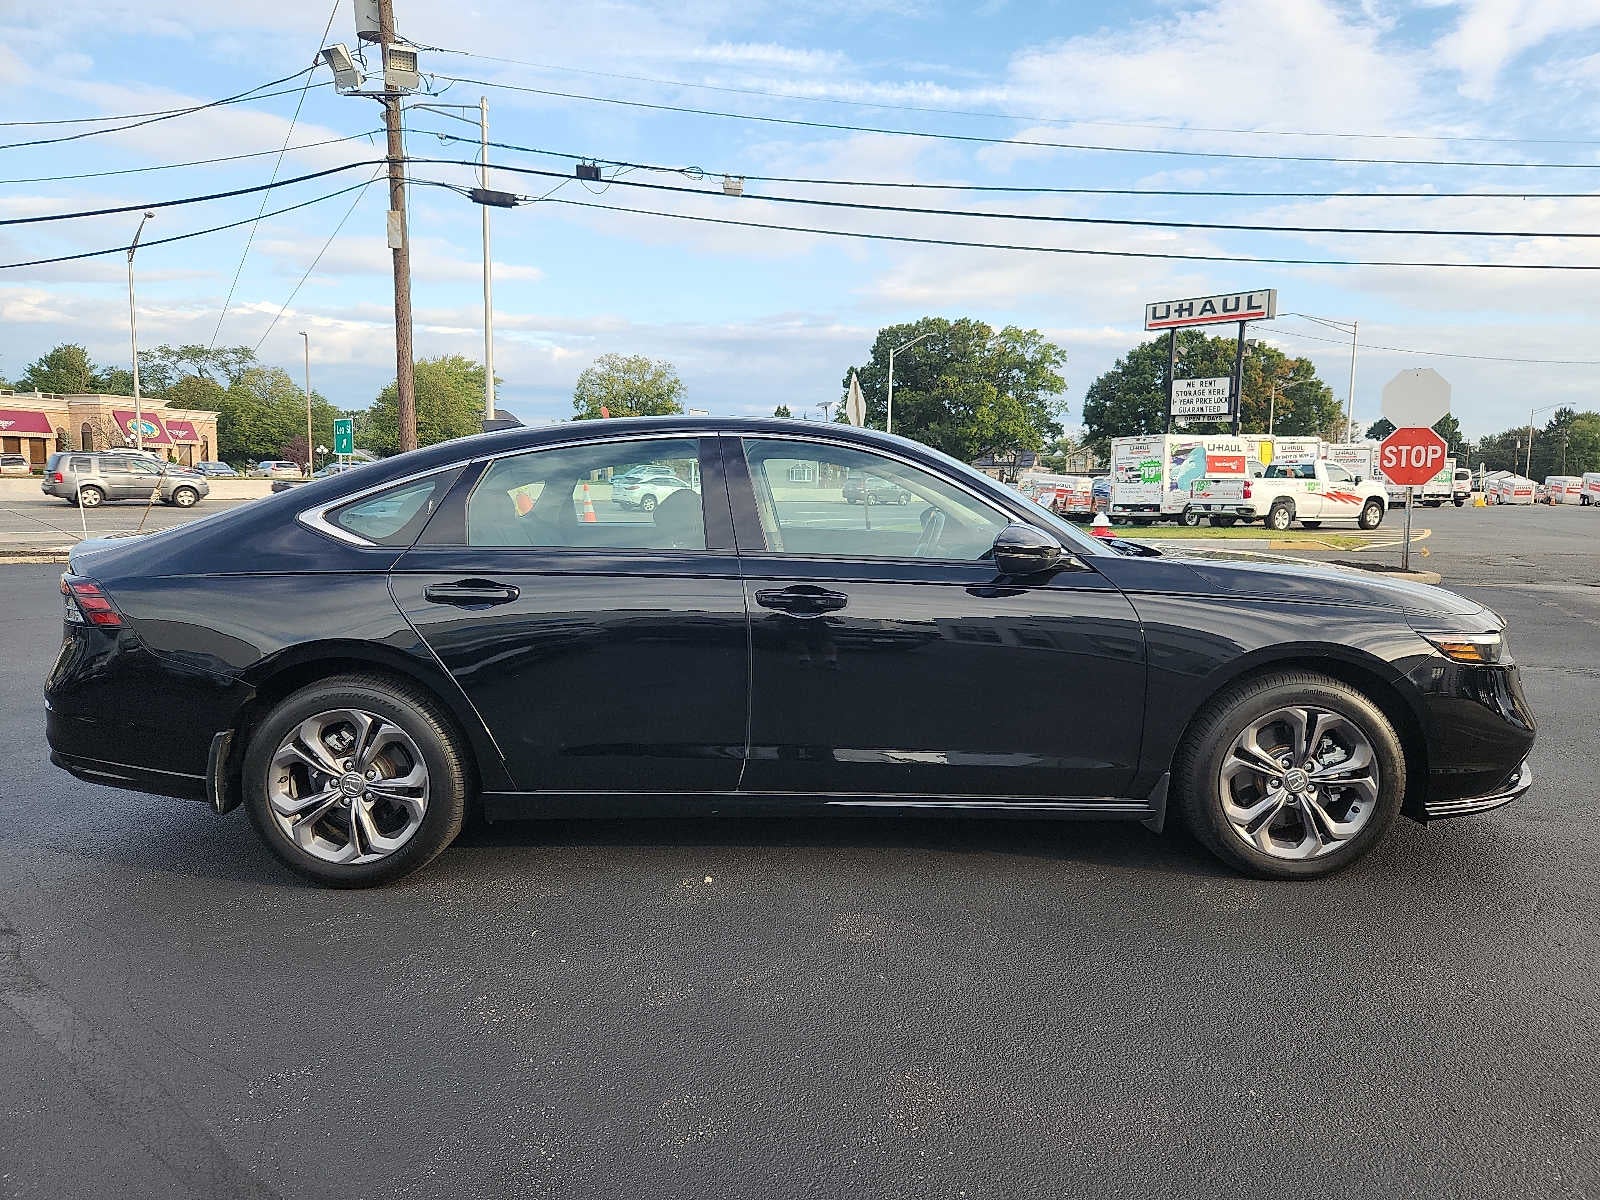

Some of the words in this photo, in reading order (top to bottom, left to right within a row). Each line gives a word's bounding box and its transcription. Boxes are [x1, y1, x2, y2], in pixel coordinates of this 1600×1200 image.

[1175, 389, 1205, 397] STORAGE
[1195, 397, 1212, 405] PRICE
[1178, 405, 1221, 413] GUARANTEED
[1383, 445, 1442, 468] STOP
